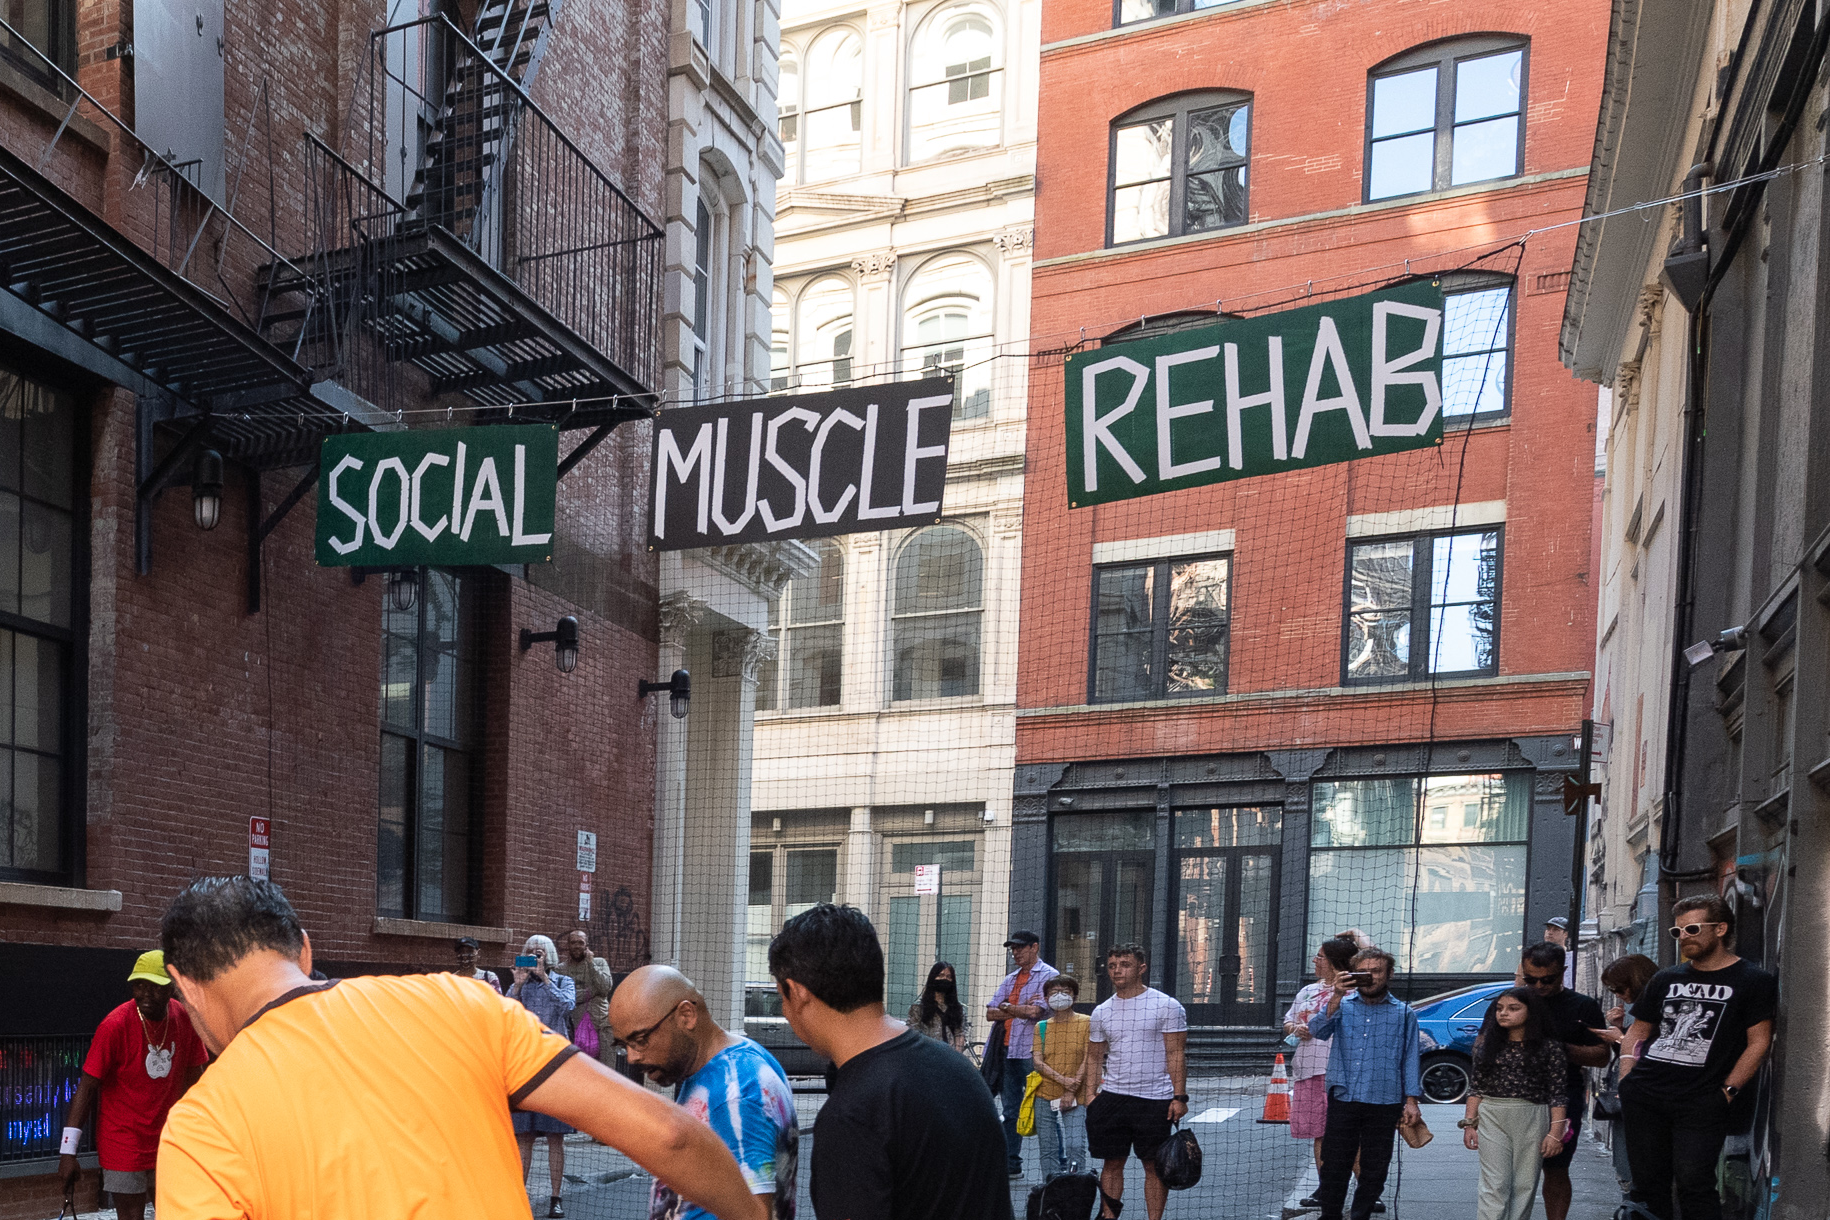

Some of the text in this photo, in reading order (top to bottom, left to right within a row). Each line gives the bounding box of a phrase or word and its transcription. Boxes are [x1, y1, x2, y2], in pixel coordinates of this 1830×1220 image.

[1081, 300, 1443, 493] REHAB
[327, 440, 552, 555] SOCIAL
[654, 393, 953, 540] MUSCLE
[252, 834, 269, 846] PARKING
[256, 822, 265, 833] NO
[1665, 982, 1733, 1000] DEAD
